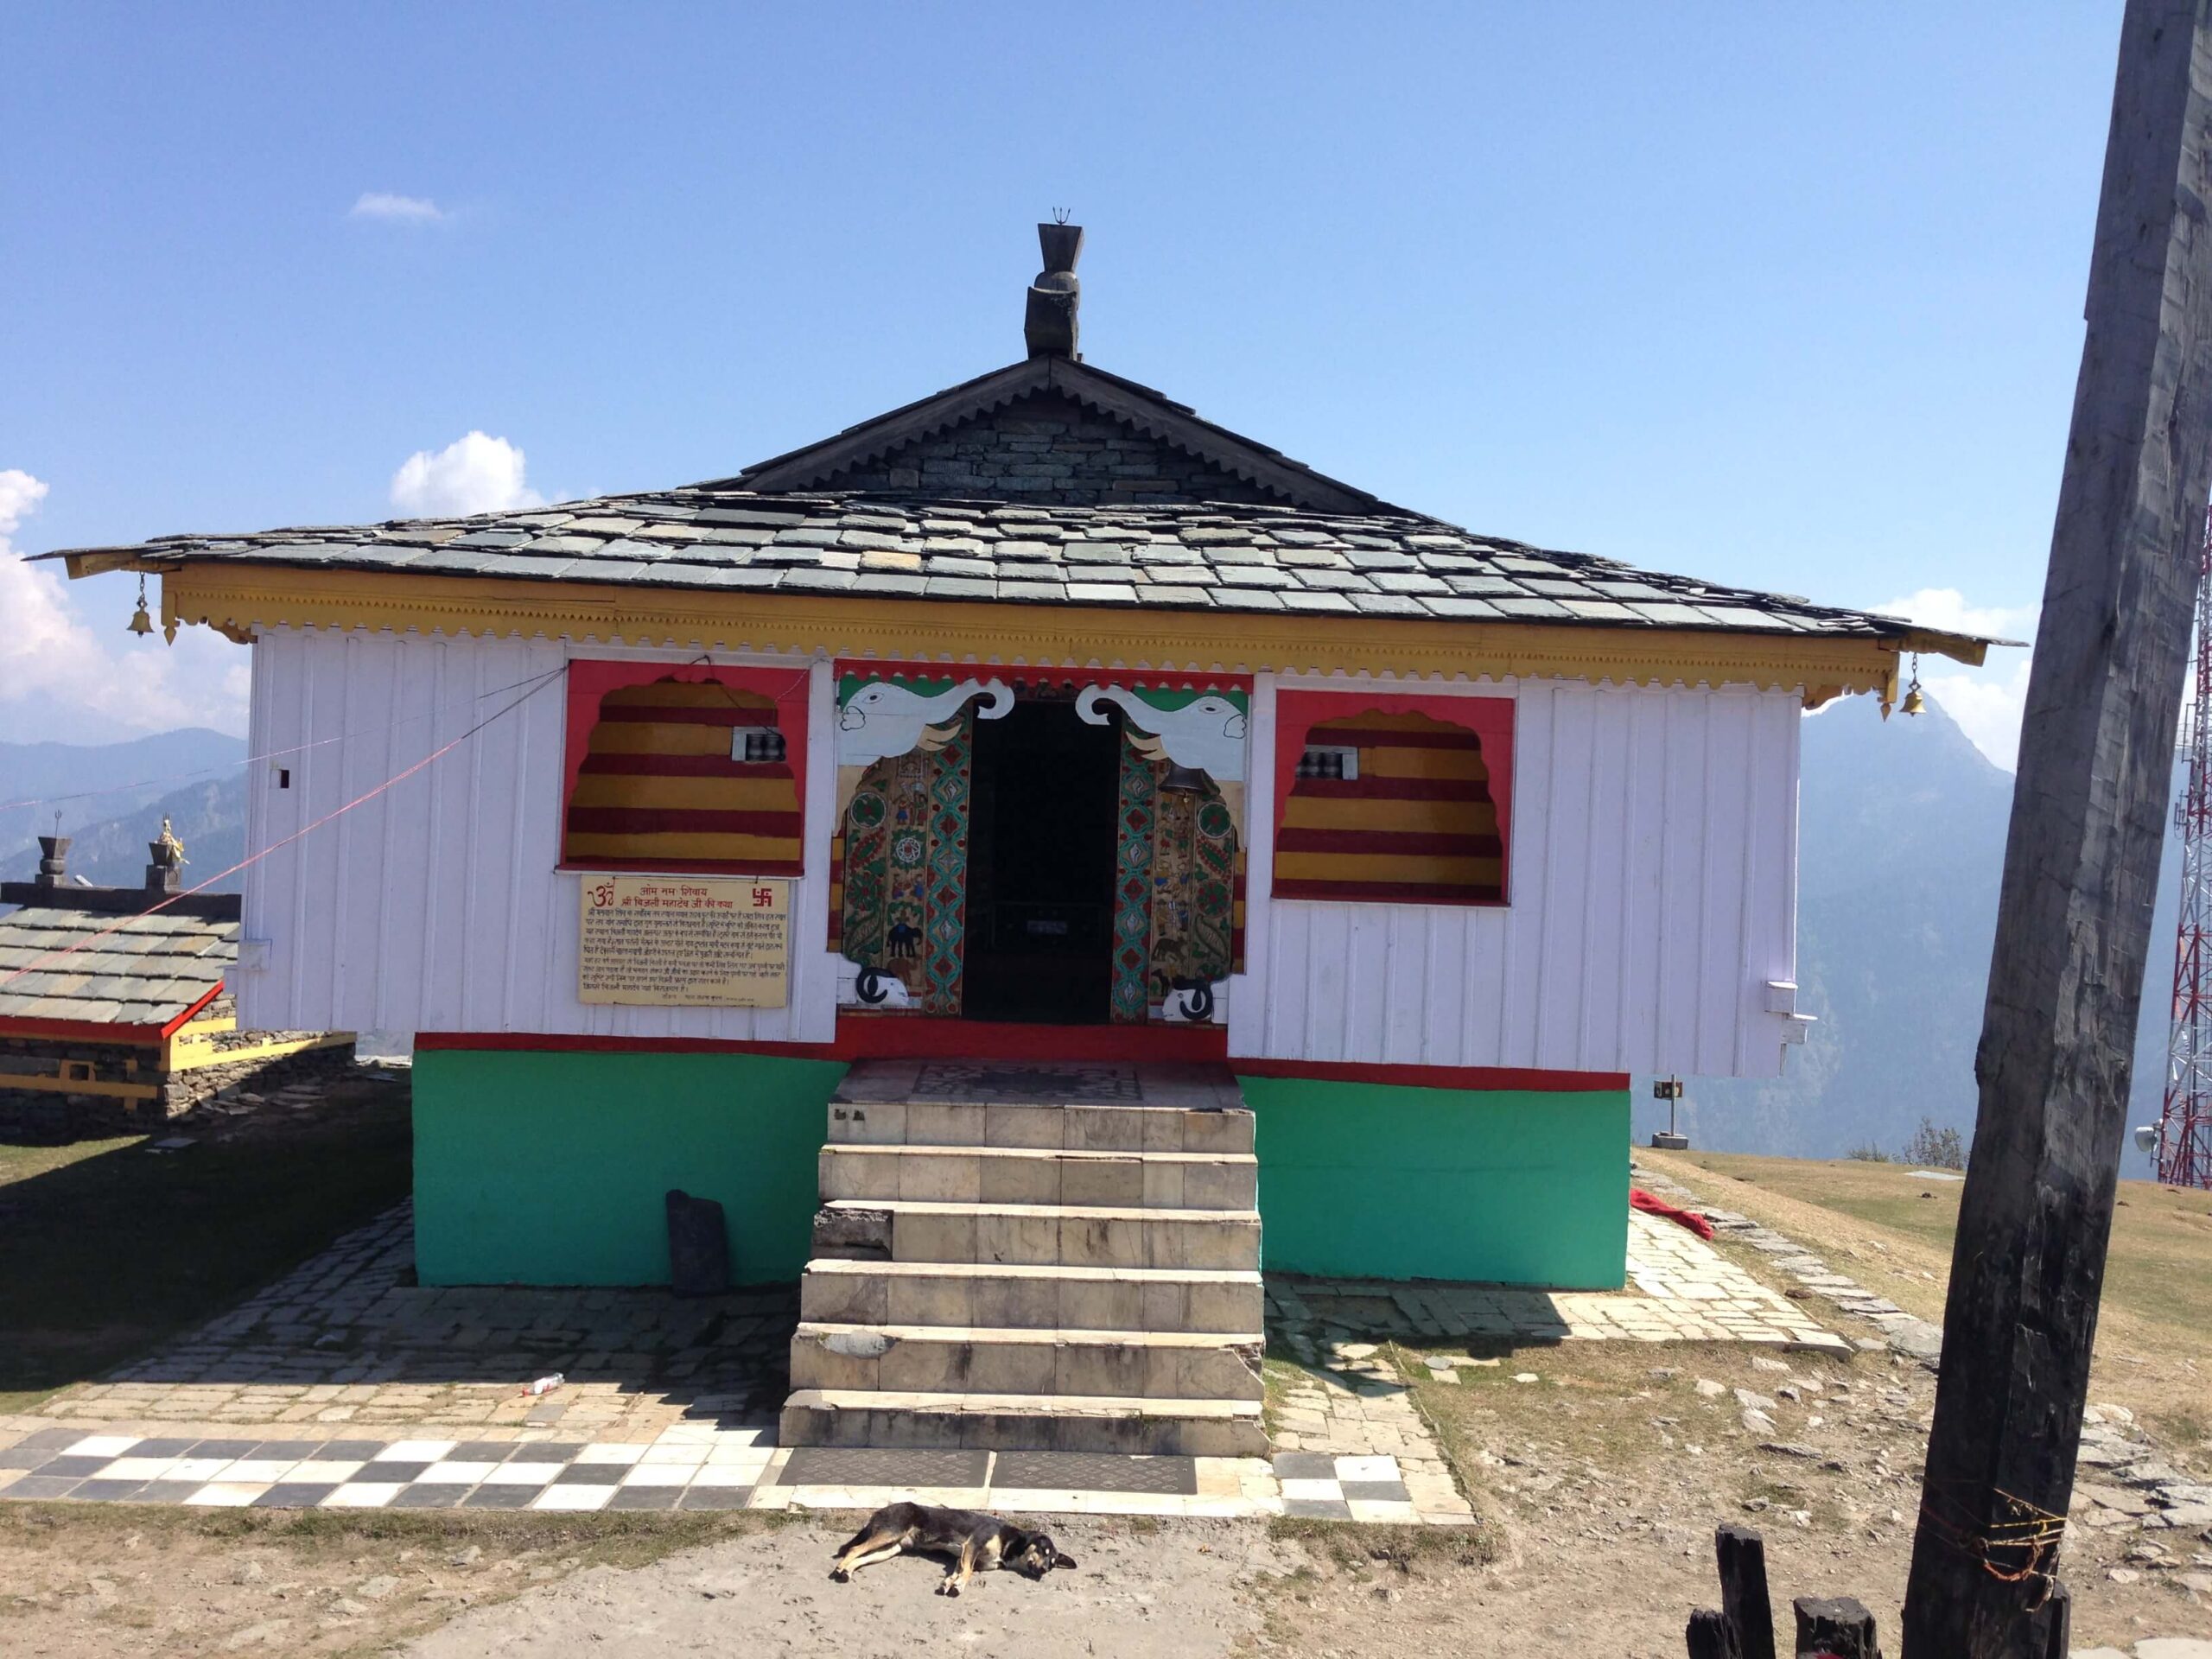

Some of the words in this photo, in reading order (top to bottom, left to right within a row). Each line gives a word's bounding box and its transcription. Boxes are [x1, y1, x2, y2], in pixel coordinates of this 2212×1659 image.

[640, 884, 658, 896] ओम
[681, 884, 708, 897] शिवाय
[621, 896, 632, 907] श्री
[662, 897, 689, 908] महादेव
[691, 897, 702, 909] जी
[704, 898, 715, 909] की
